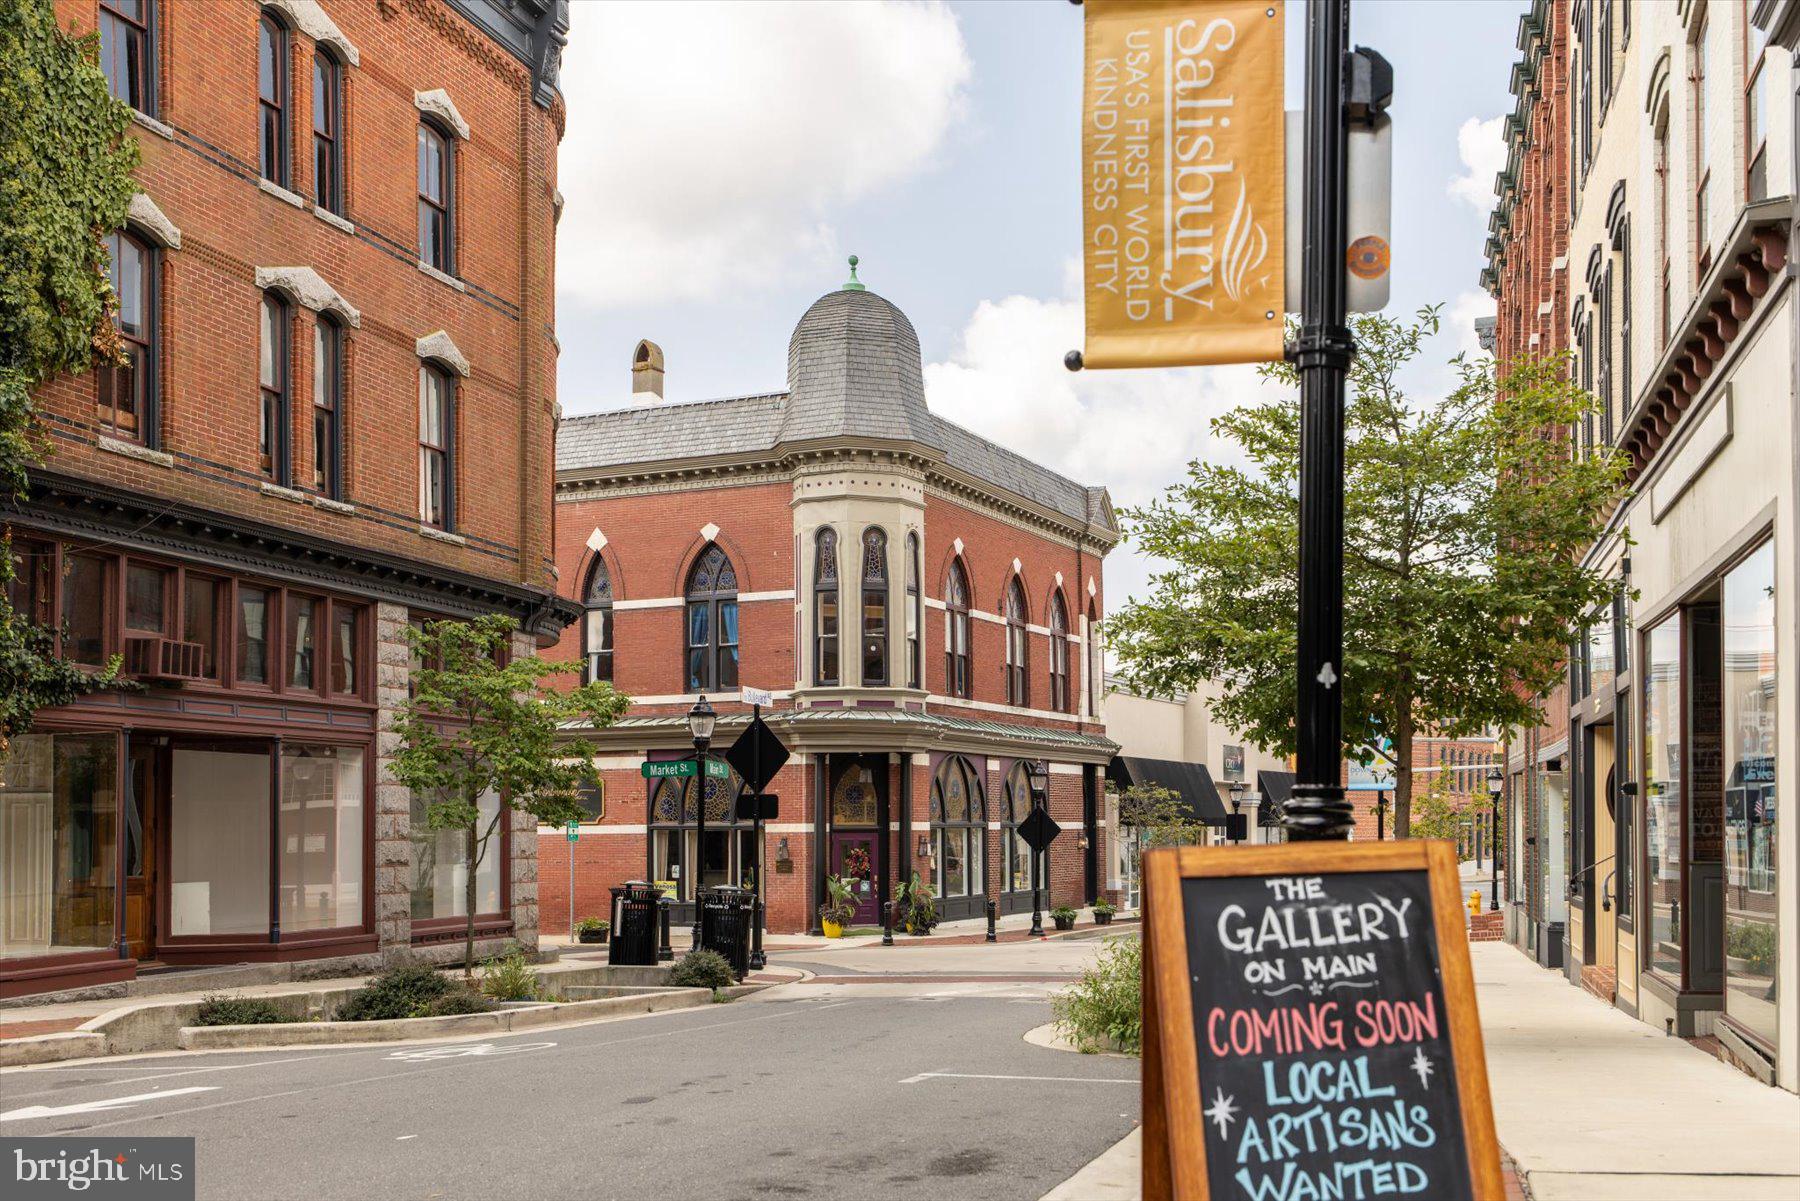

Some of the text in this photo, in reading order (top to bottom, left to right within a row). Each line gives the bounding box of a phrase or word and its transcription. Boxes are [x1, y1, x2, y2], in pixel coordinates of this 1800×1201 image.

[1093, 58, 1119, 294] KINDNESS CITY
[1124, 118, 1150, 193] FIRST
[1161, 18, 1235, 310] Salisbury
[1124, 204, 1150, 321] WORLD
[649, 764, 678, 776] Market
[1266, 877, 1326, 902] THE
[1217, 897, 1413, 955] GALLERY
[1244, 952, 1378, 985] ON MAIN
[1207, 992, 1439, 1057] COMING SOON
[1262, 1055, 1396, 1107] LOCAL
[1236, 1100, 1437, 1164] ARTISANS
[1235, 1160, 1429, 1201] WANTED
